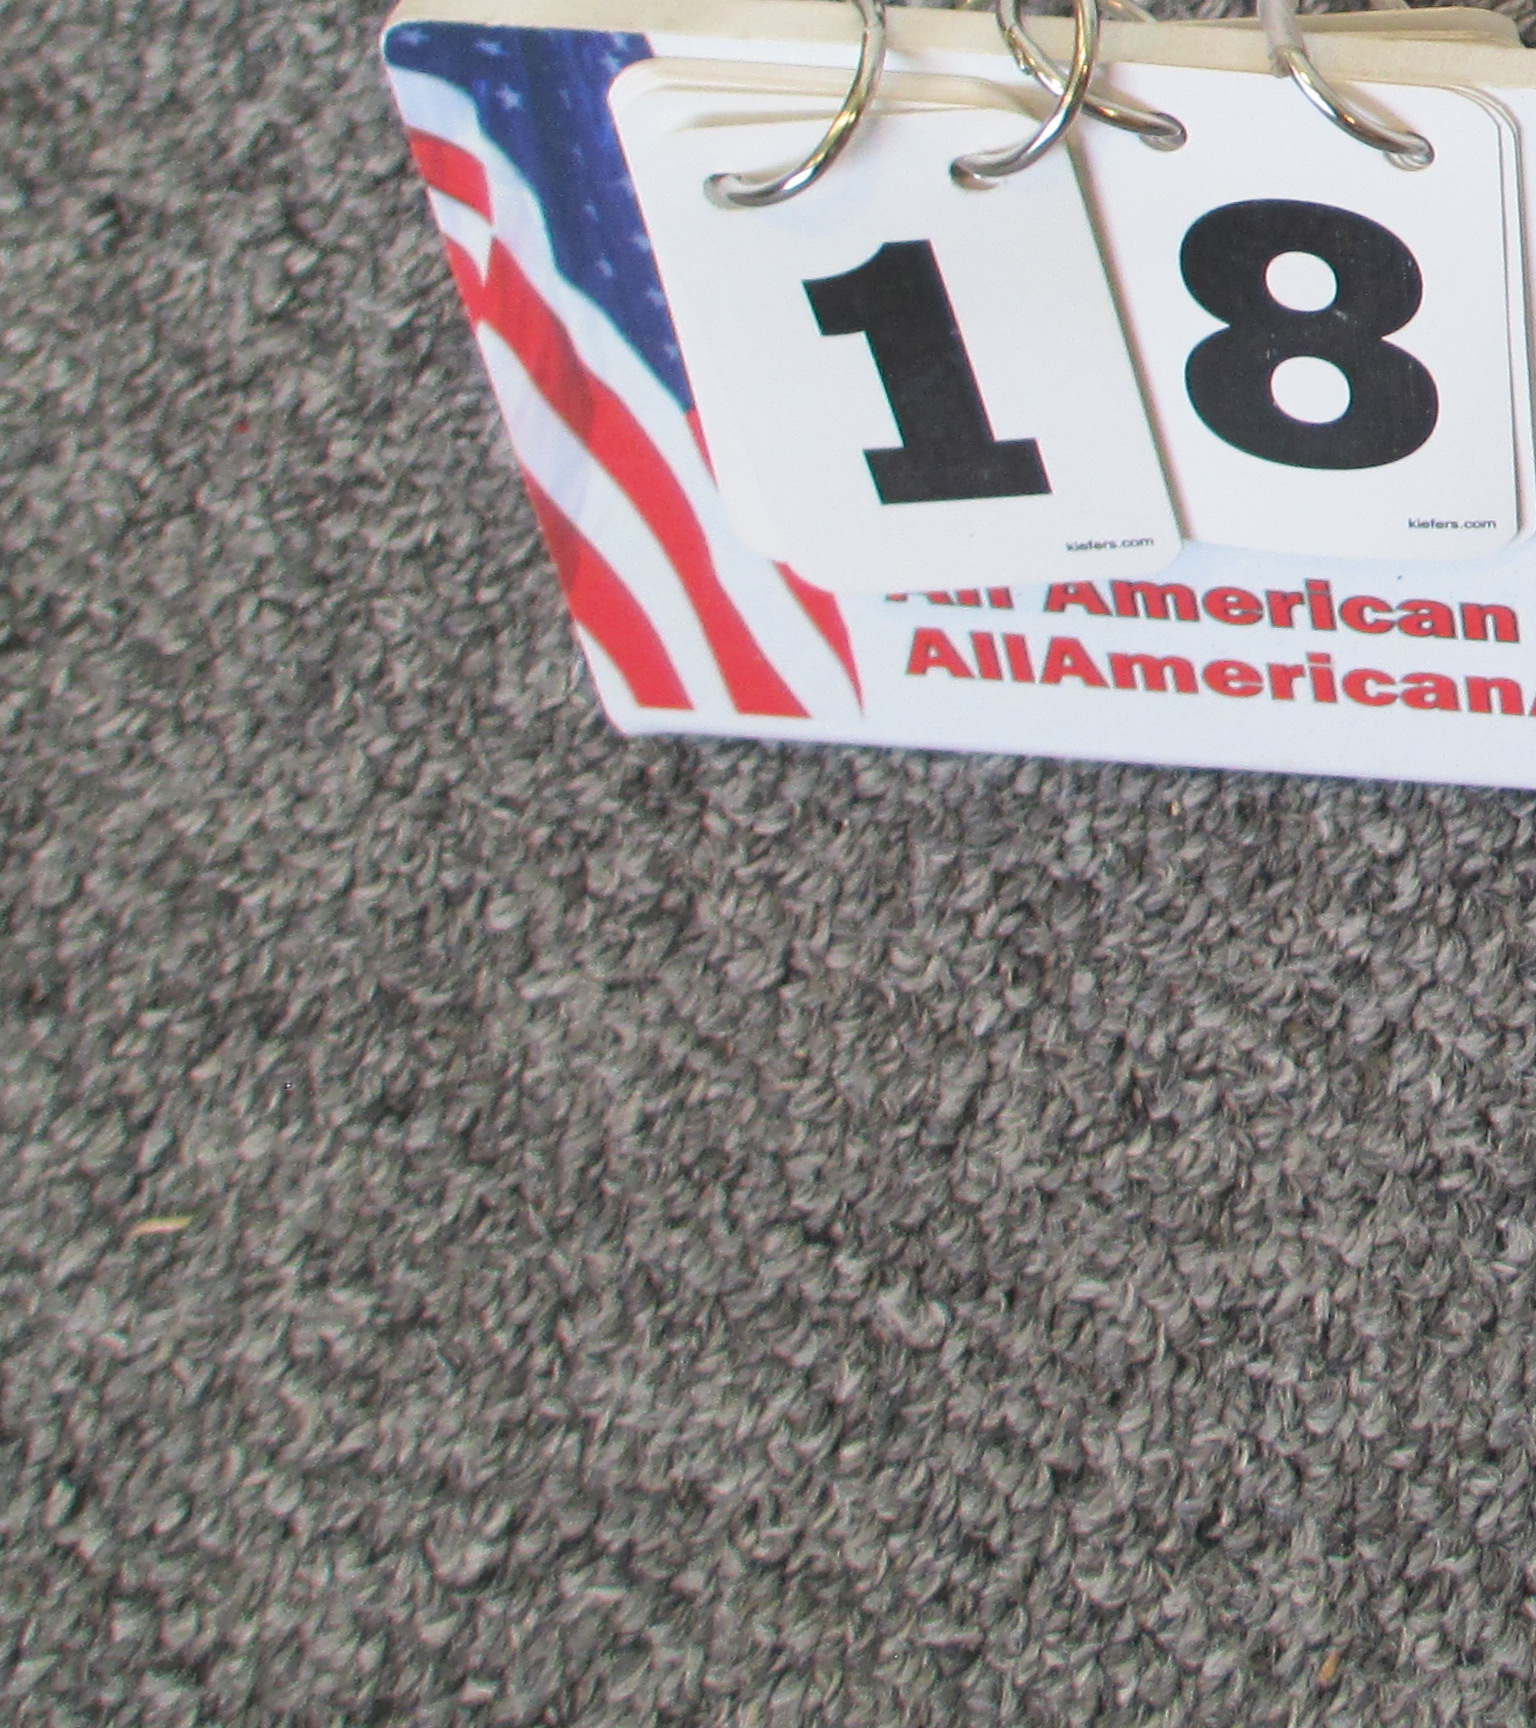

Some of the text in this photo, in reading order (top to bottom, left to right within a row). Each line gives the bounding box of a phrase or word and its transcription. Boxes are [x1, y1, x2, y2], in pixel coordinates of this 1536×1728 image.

[803, 239, 1051, 505] 1
[1179, 198, 1439, 470] 8
[1065, 536, 1154, 553] kiefers.com
[1408, 517, 1497, 532] kiefers.com
[1043, 577, 1521, 644] American
